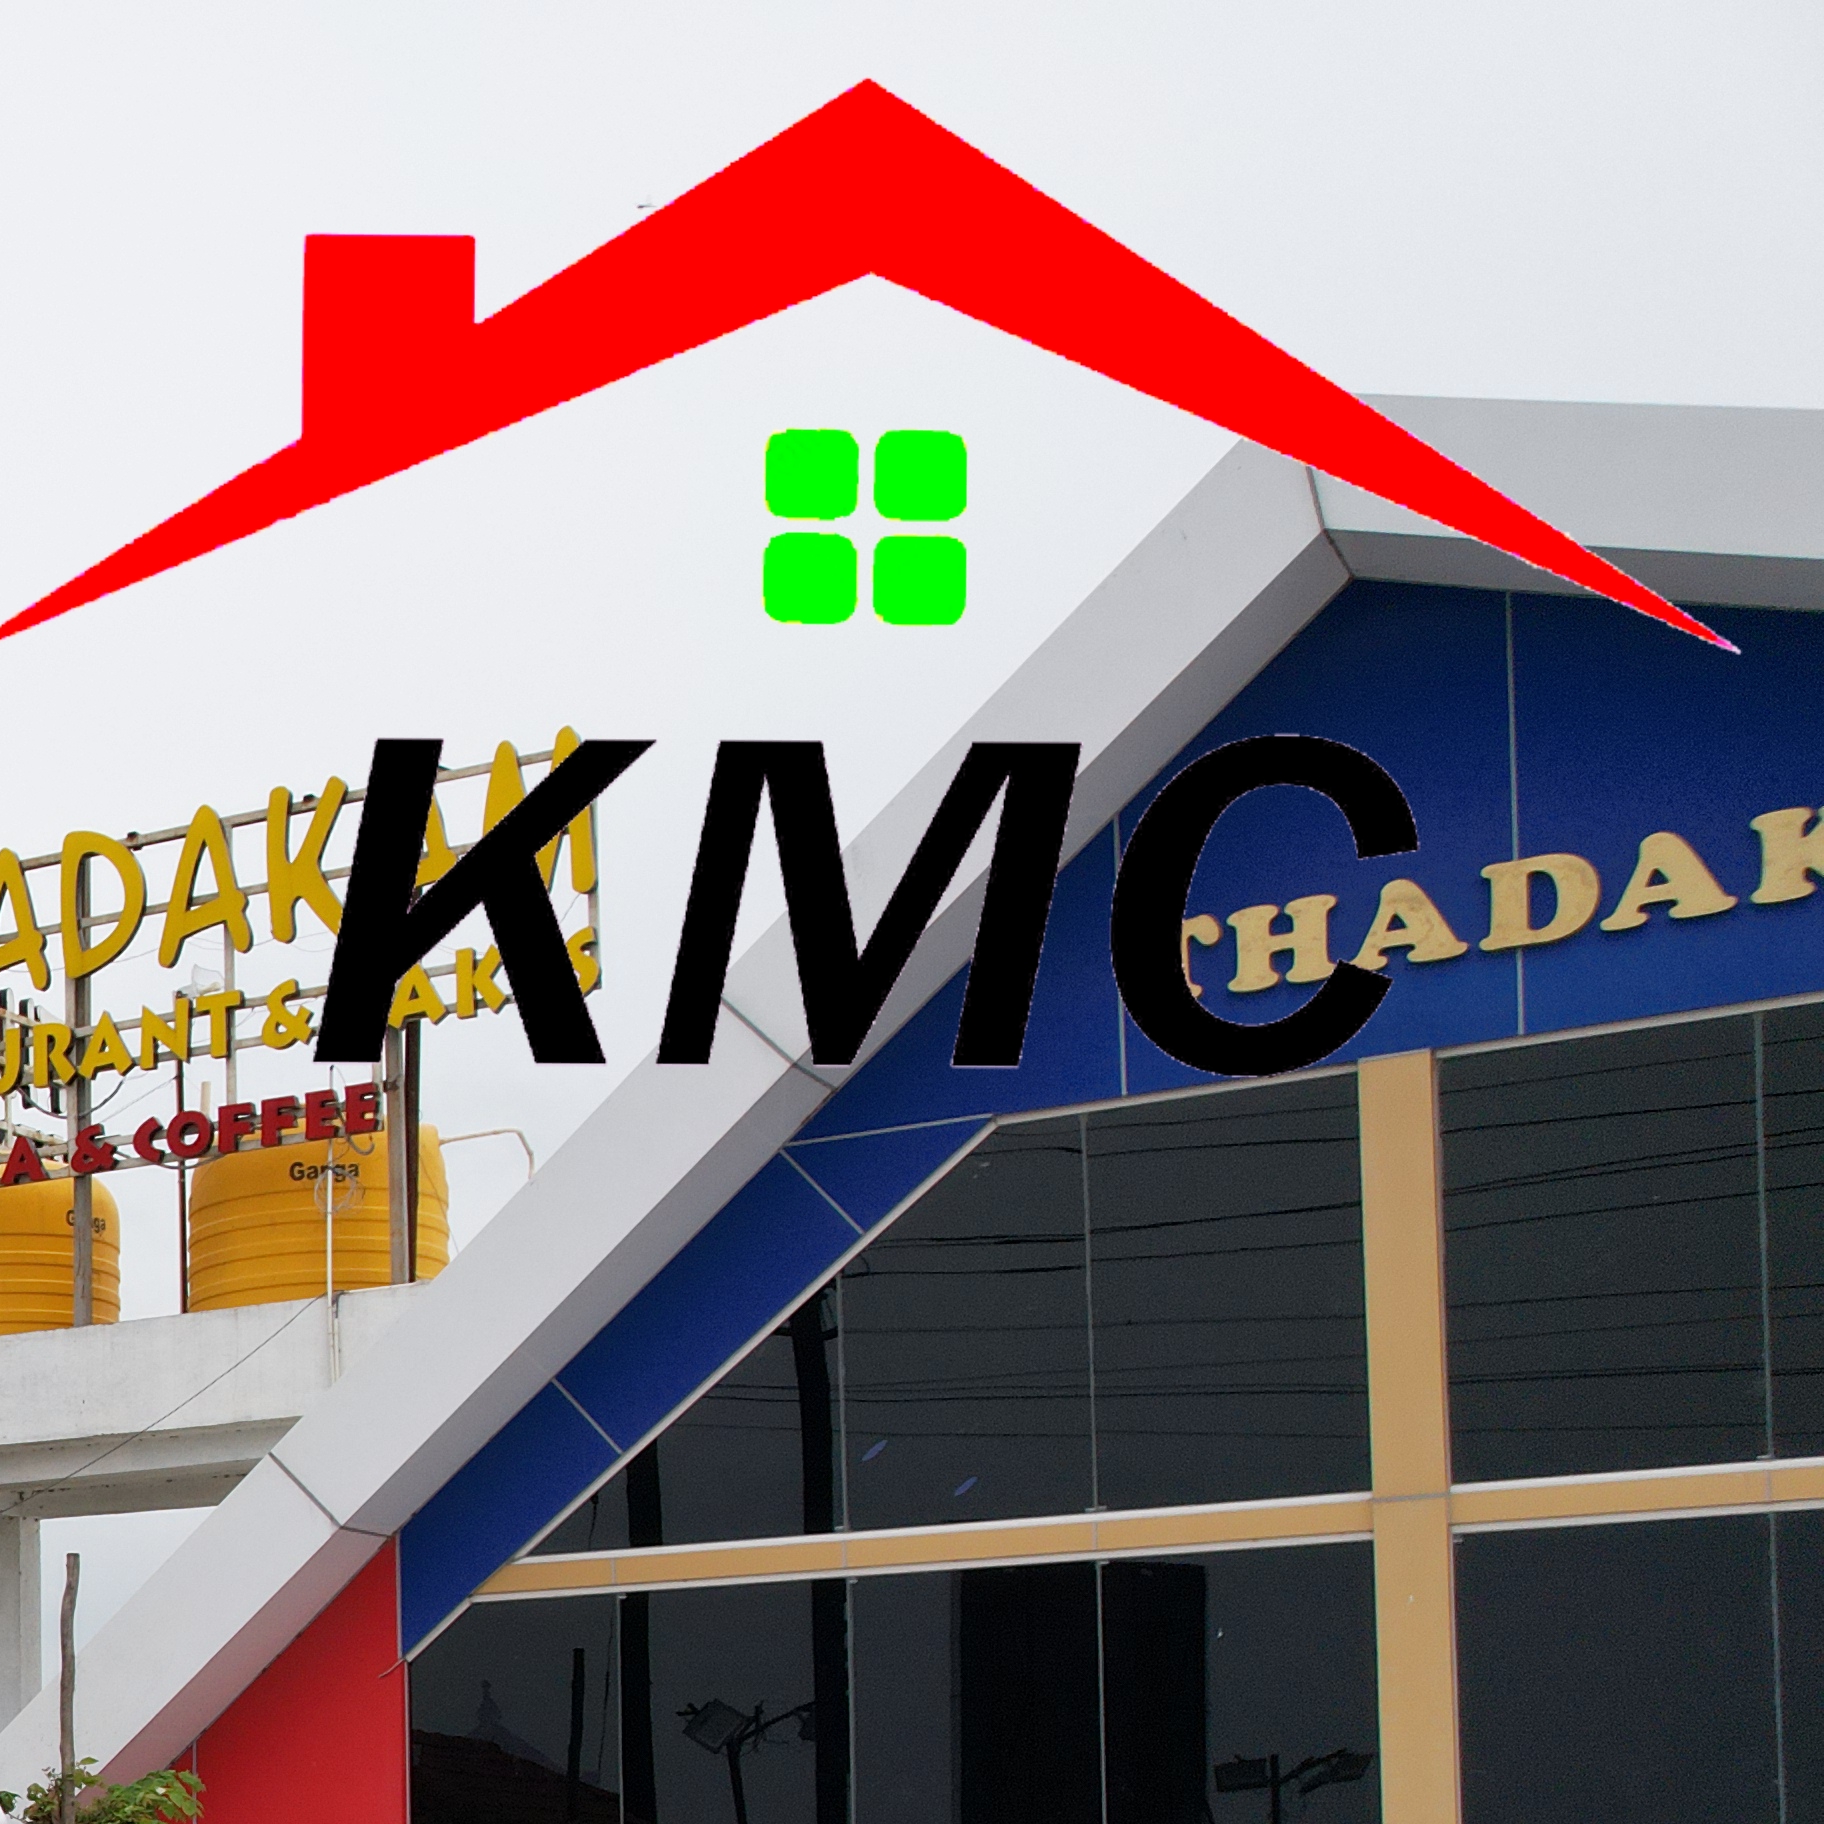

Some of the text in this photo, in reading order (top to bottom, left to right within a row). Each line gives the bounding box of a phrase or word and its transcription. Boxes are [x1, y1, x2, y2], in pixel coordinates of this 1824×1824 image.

[261, 978, 314, 1050] &
[388, 925, 600, 1030] AKS
[70, 1123, 117, 1174] &
[133, 1082, 380, 1164] COFFEE
[66, 1210, 106, 1233] Gga
